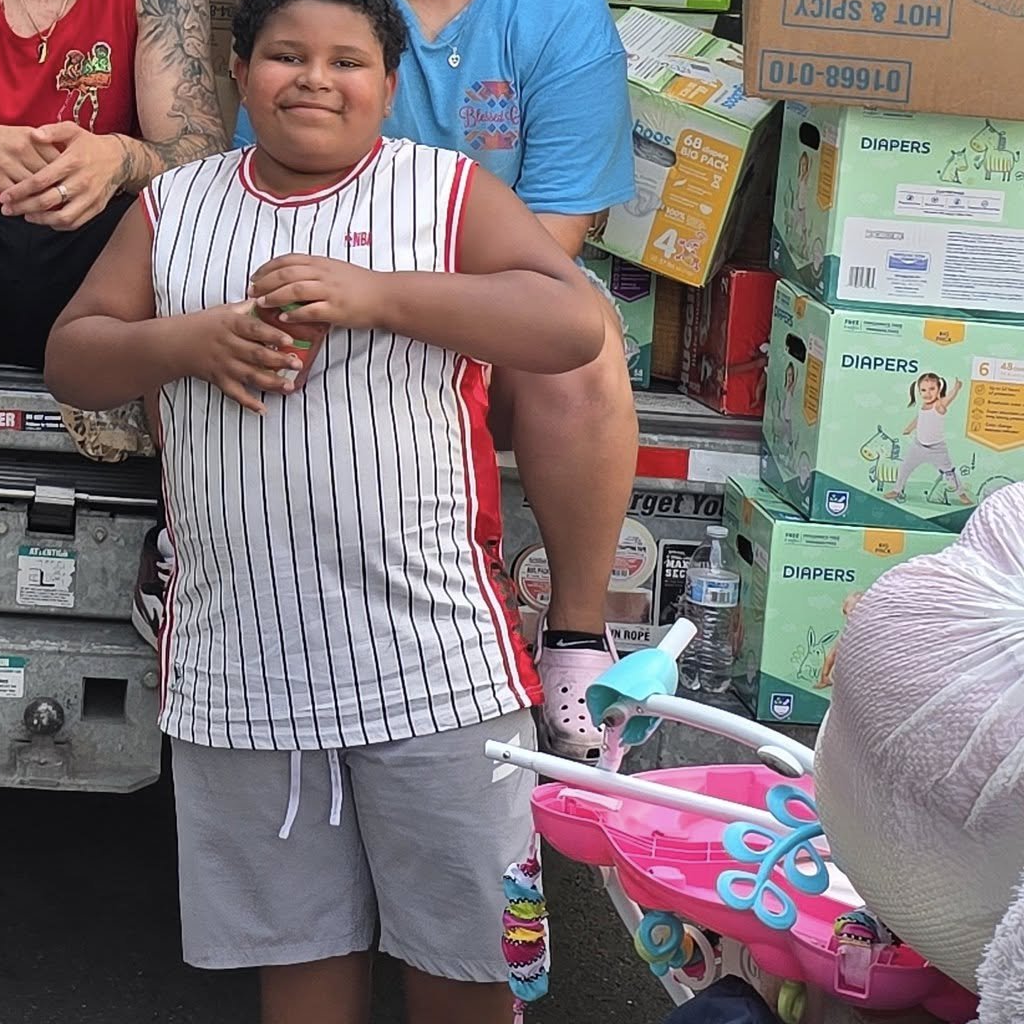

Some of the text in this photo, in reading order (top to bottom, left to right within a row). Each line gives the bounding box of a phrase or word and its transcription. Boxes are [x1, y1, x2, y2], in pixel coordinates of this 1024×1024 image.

[872, 1, 886, 23] &
[894, 3, 941, 26] HOT
[769, 60, 901, 93] 01668-010
[683, 134, 703, 150] 68
[861, 137, 931, 154] DIAPERS
[679, 147, 729, 172] BIG PACK
[653, 228, 678, 257] 4
[678, 287, 695, 393] HUGGI
[842, 354, 919, 374] DIAPERS
[979, 362, 990, 376] 6
[629, 491, 724, 516] rget Yo
[665, 568, 687, 578] SEC
[666, 559, 690, 569] MAX
[783, 565, 856, 583] DIAPERS
[624, 630, 650, 642] ROPE
